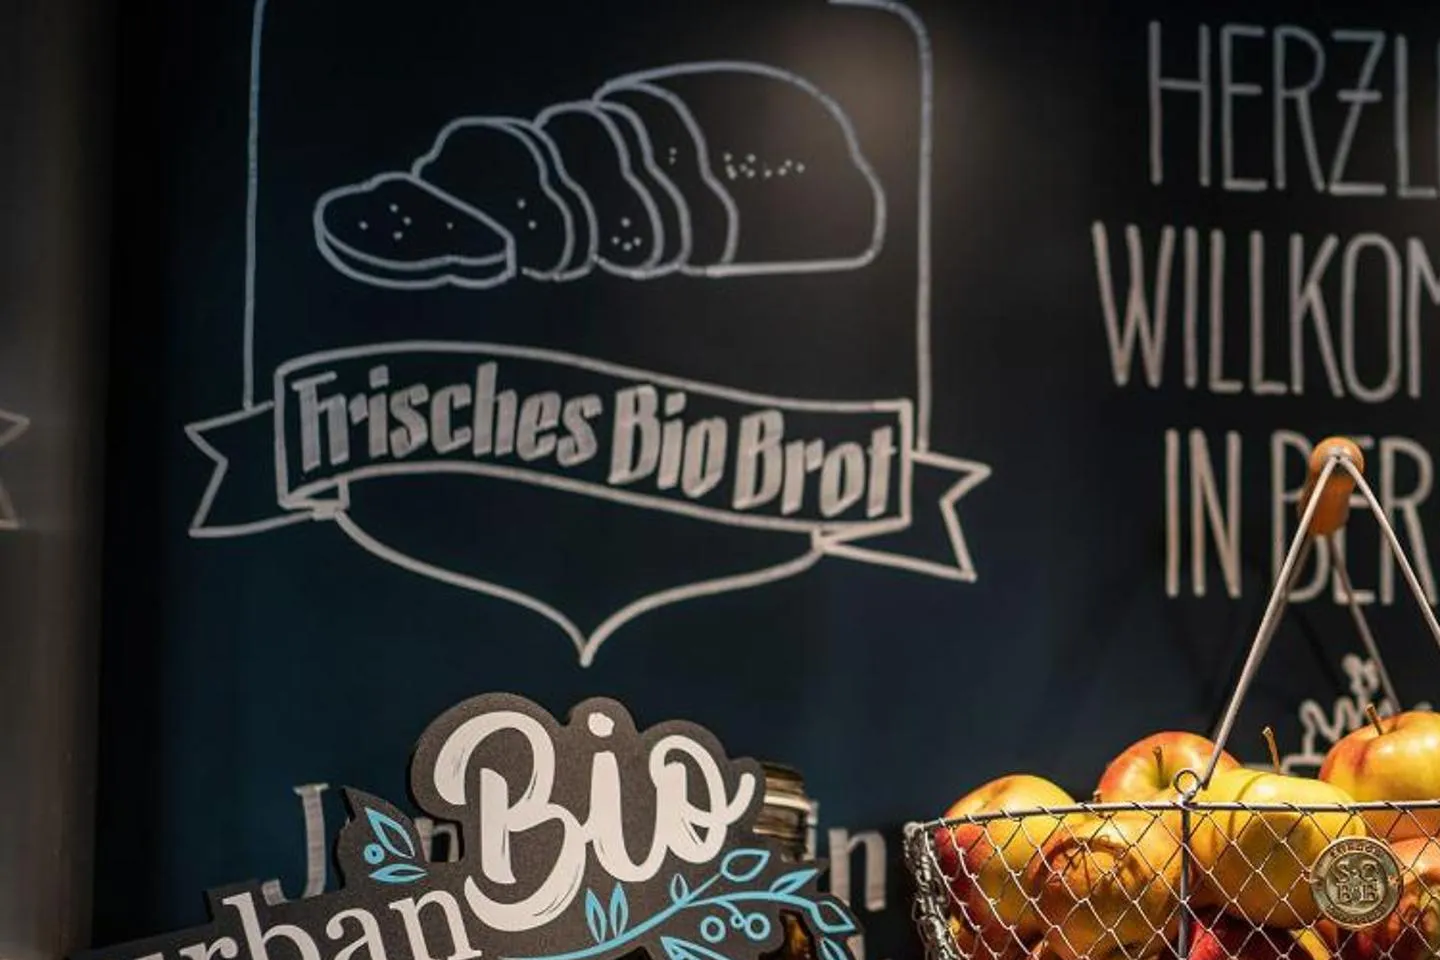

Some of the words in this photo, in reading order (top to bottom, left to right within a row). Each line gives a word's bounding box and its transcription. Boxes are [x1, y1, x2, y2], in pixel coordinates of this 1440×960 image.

[292, 361, 603, 473] Frisches
[608, 383, 727, 499] Bio
[732, 408, 896, 520] Brot
[1164, 428, 1243, 599] IN
[433, 710, 756, 932] Bio
